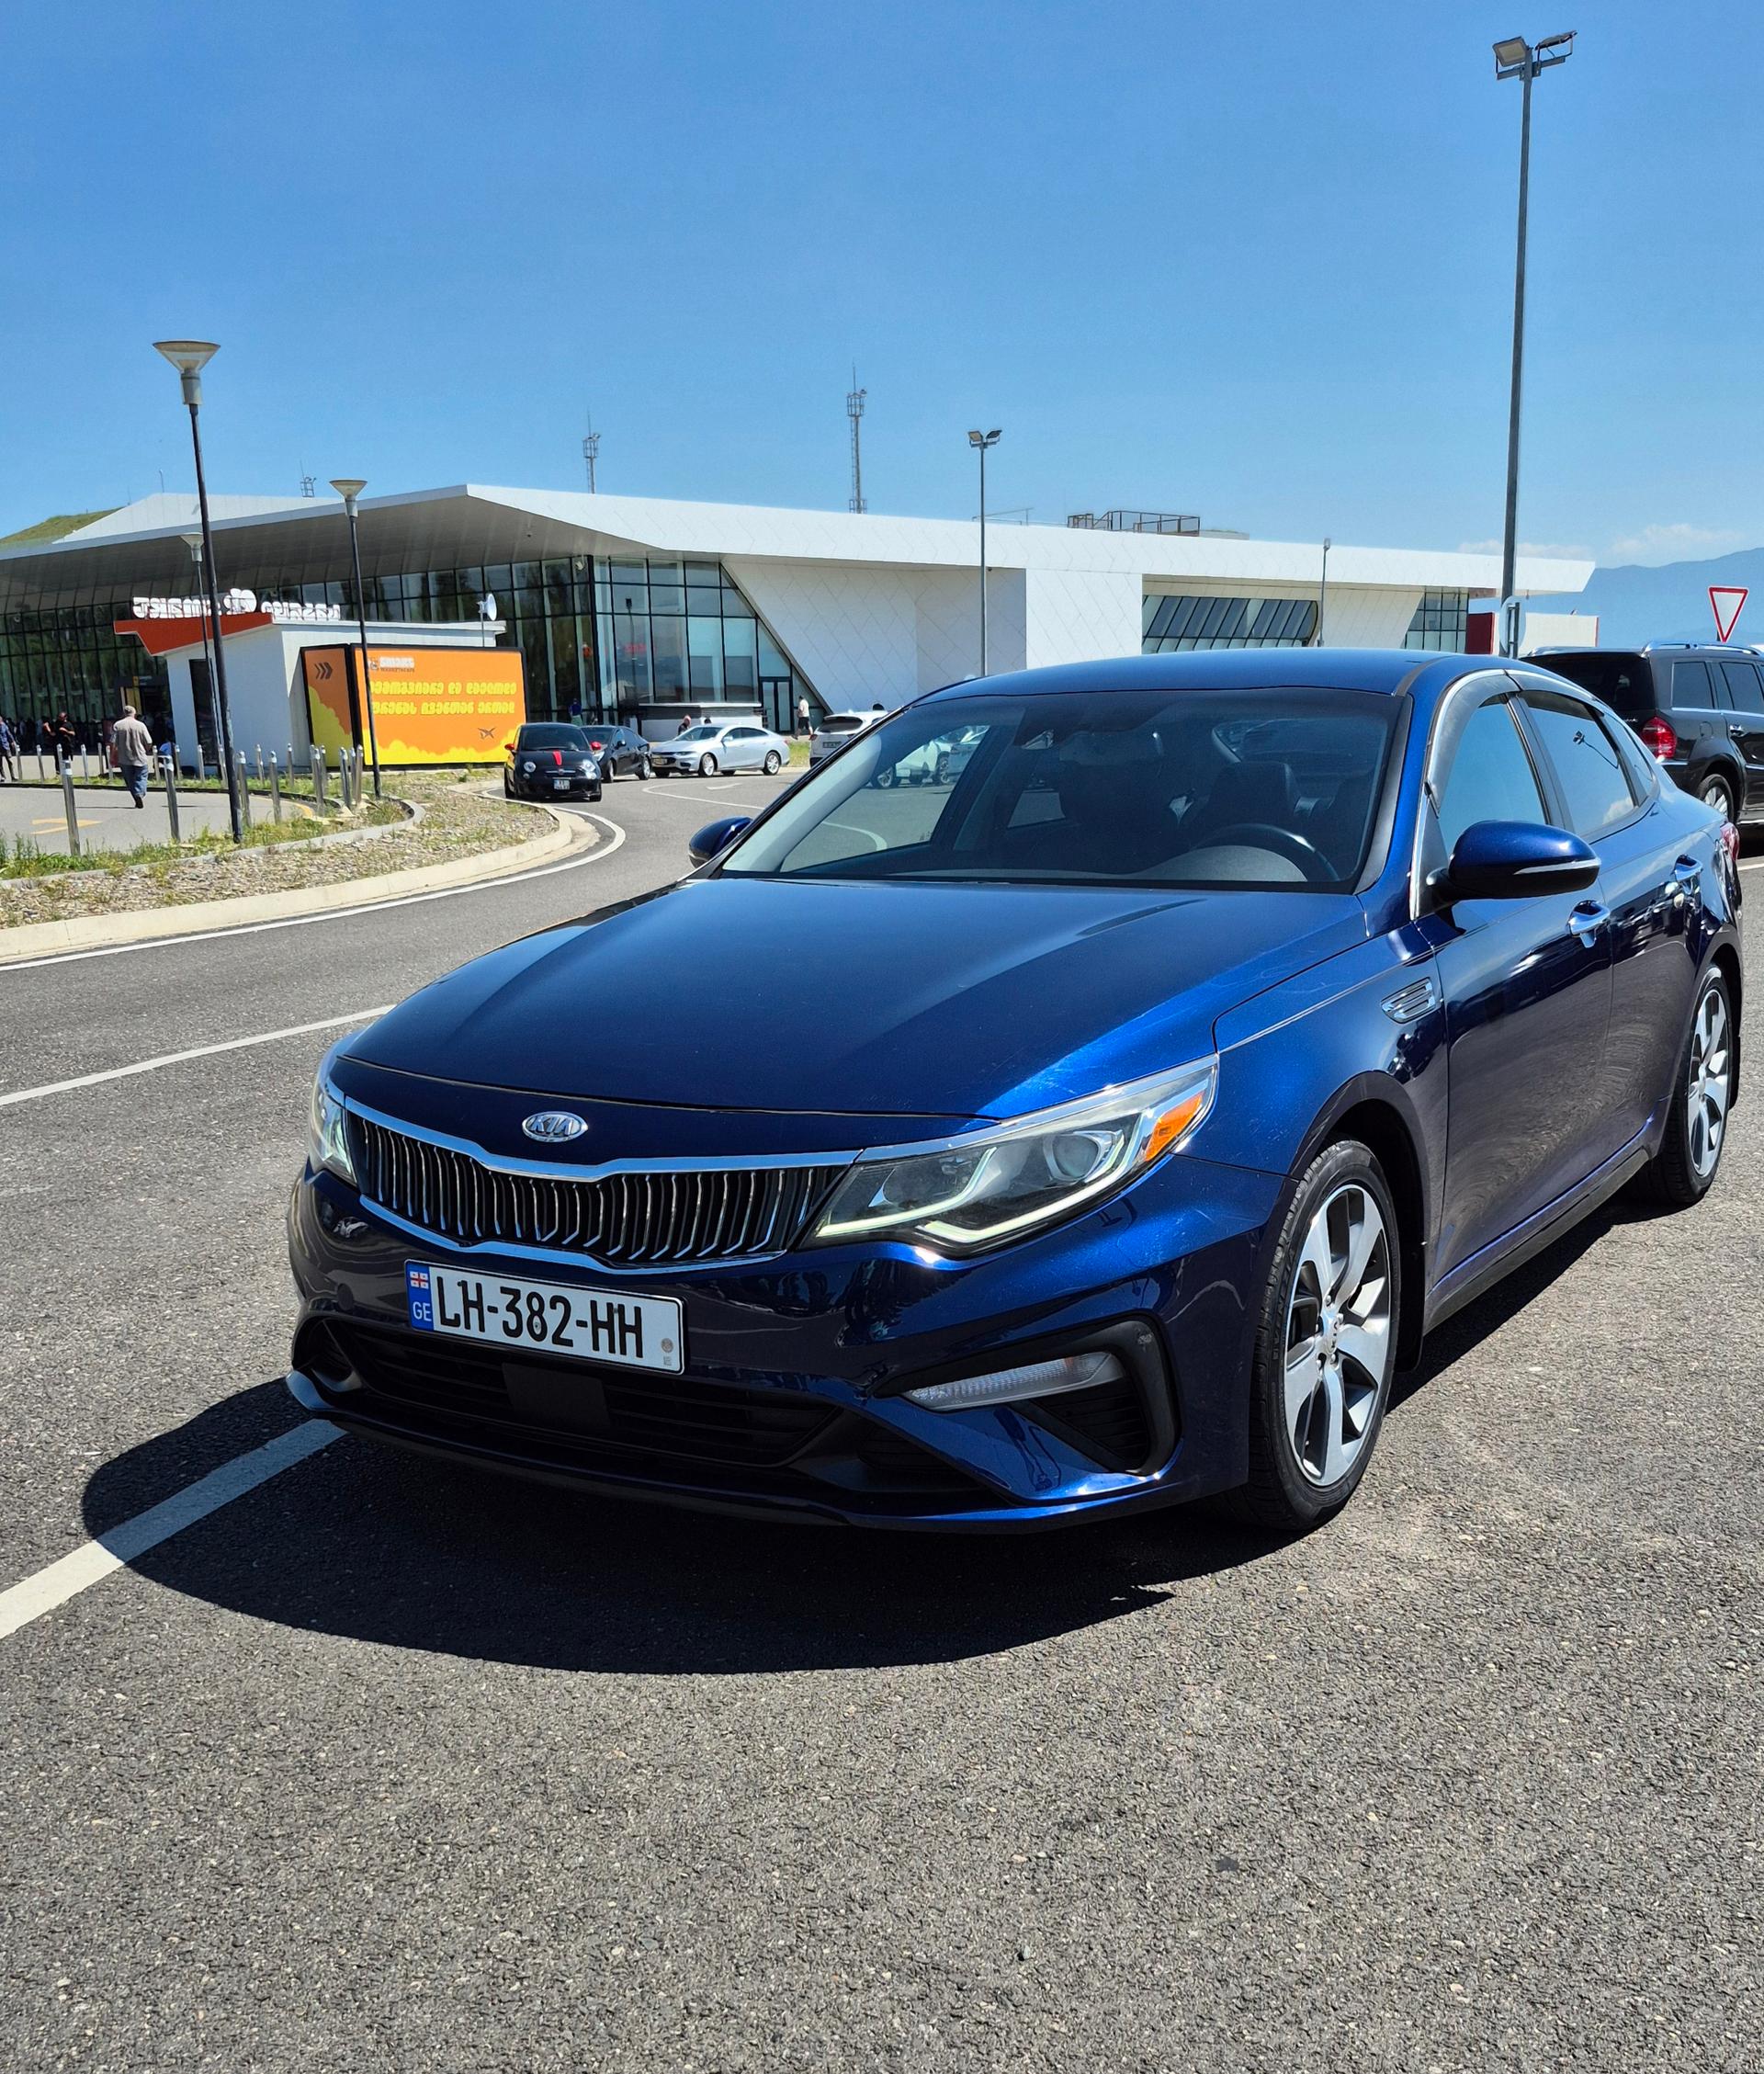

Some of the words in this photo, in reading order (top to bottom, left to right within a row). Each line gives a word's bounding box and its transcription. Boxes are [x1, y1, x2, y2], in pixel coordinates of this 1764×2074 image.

[529, 1116, 573, 1136] KIA
[413, 1301, 432, 1321] GE
[436, 1275, 643, 1358] LH-382-HH
